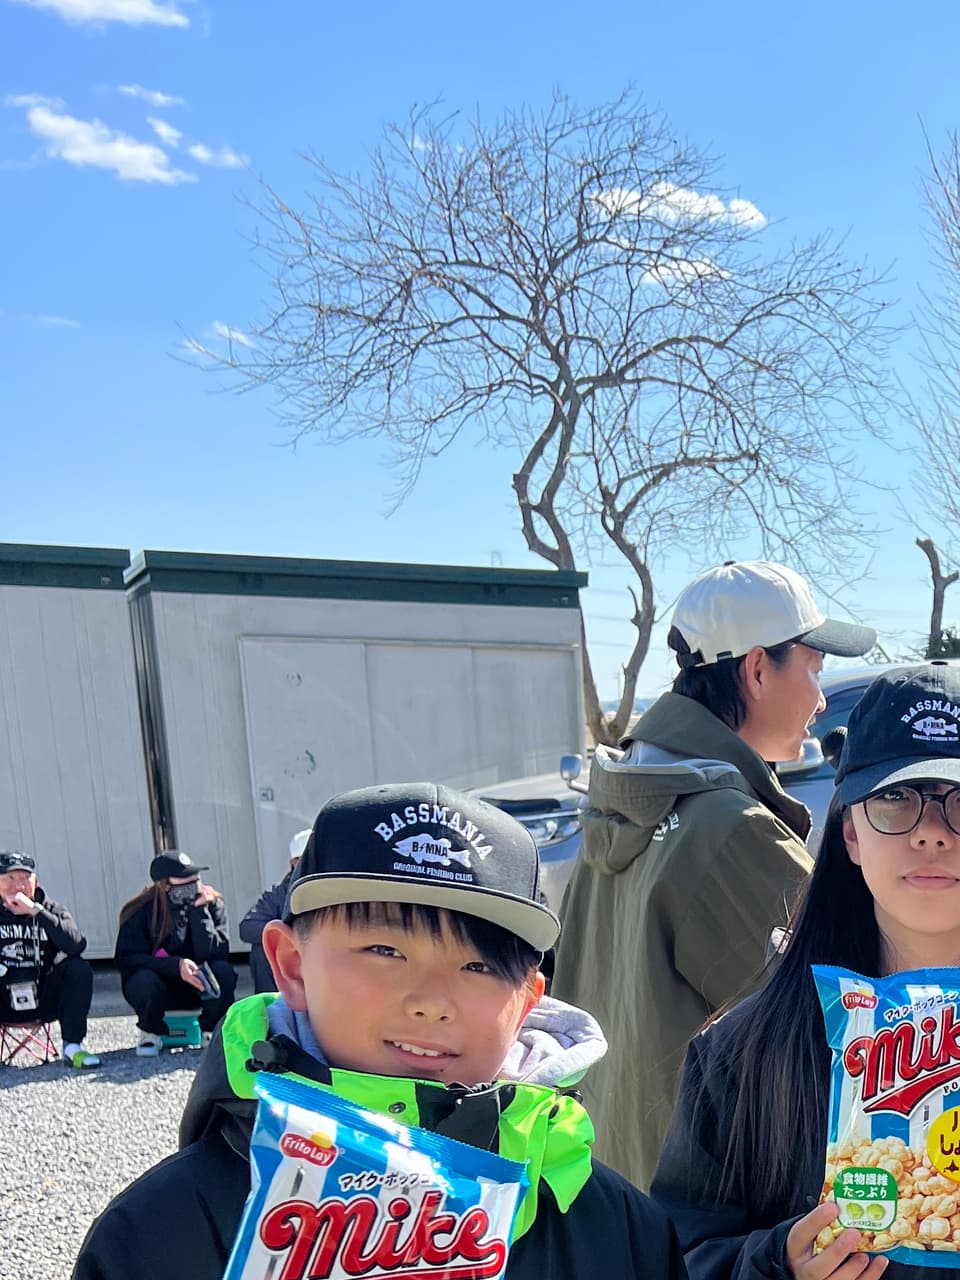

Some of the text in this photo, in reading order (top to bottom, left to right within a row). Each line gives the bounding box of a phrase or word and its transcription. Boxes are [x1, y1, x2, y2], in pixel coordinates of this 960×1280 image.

[374, 803, 493, 860] BASSMANIA
[843, 1186, 887, 1199] たっぷり
